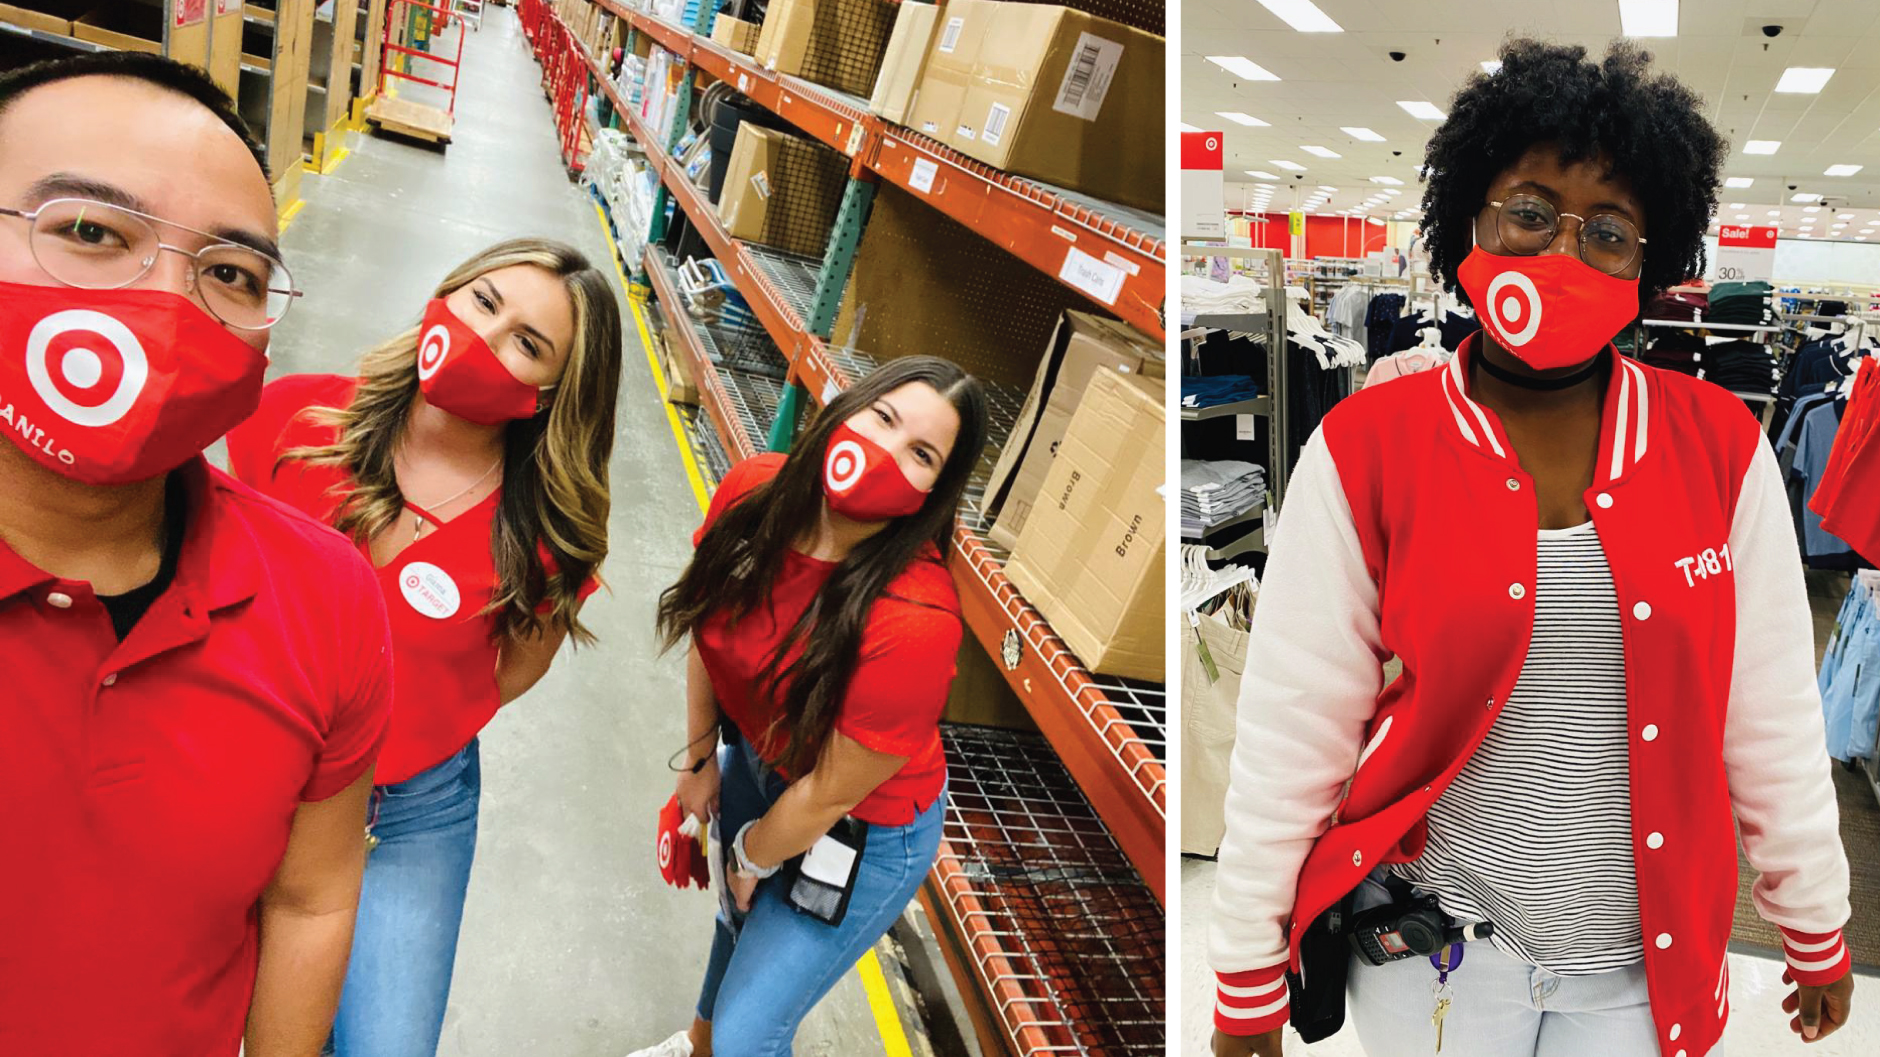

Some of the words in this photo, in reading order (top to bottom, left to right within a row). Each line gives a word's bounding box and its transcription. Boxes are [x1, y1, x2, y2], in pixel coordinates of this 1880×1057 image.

[1722, 228, 1750, 239] Sale!
[0, 393, 75, 465] ANILO
[1059, 471, 1081, 511] Brown
[1115, 514, 1143, 557] Brown
[419, 585, 451, 615] TARGET
